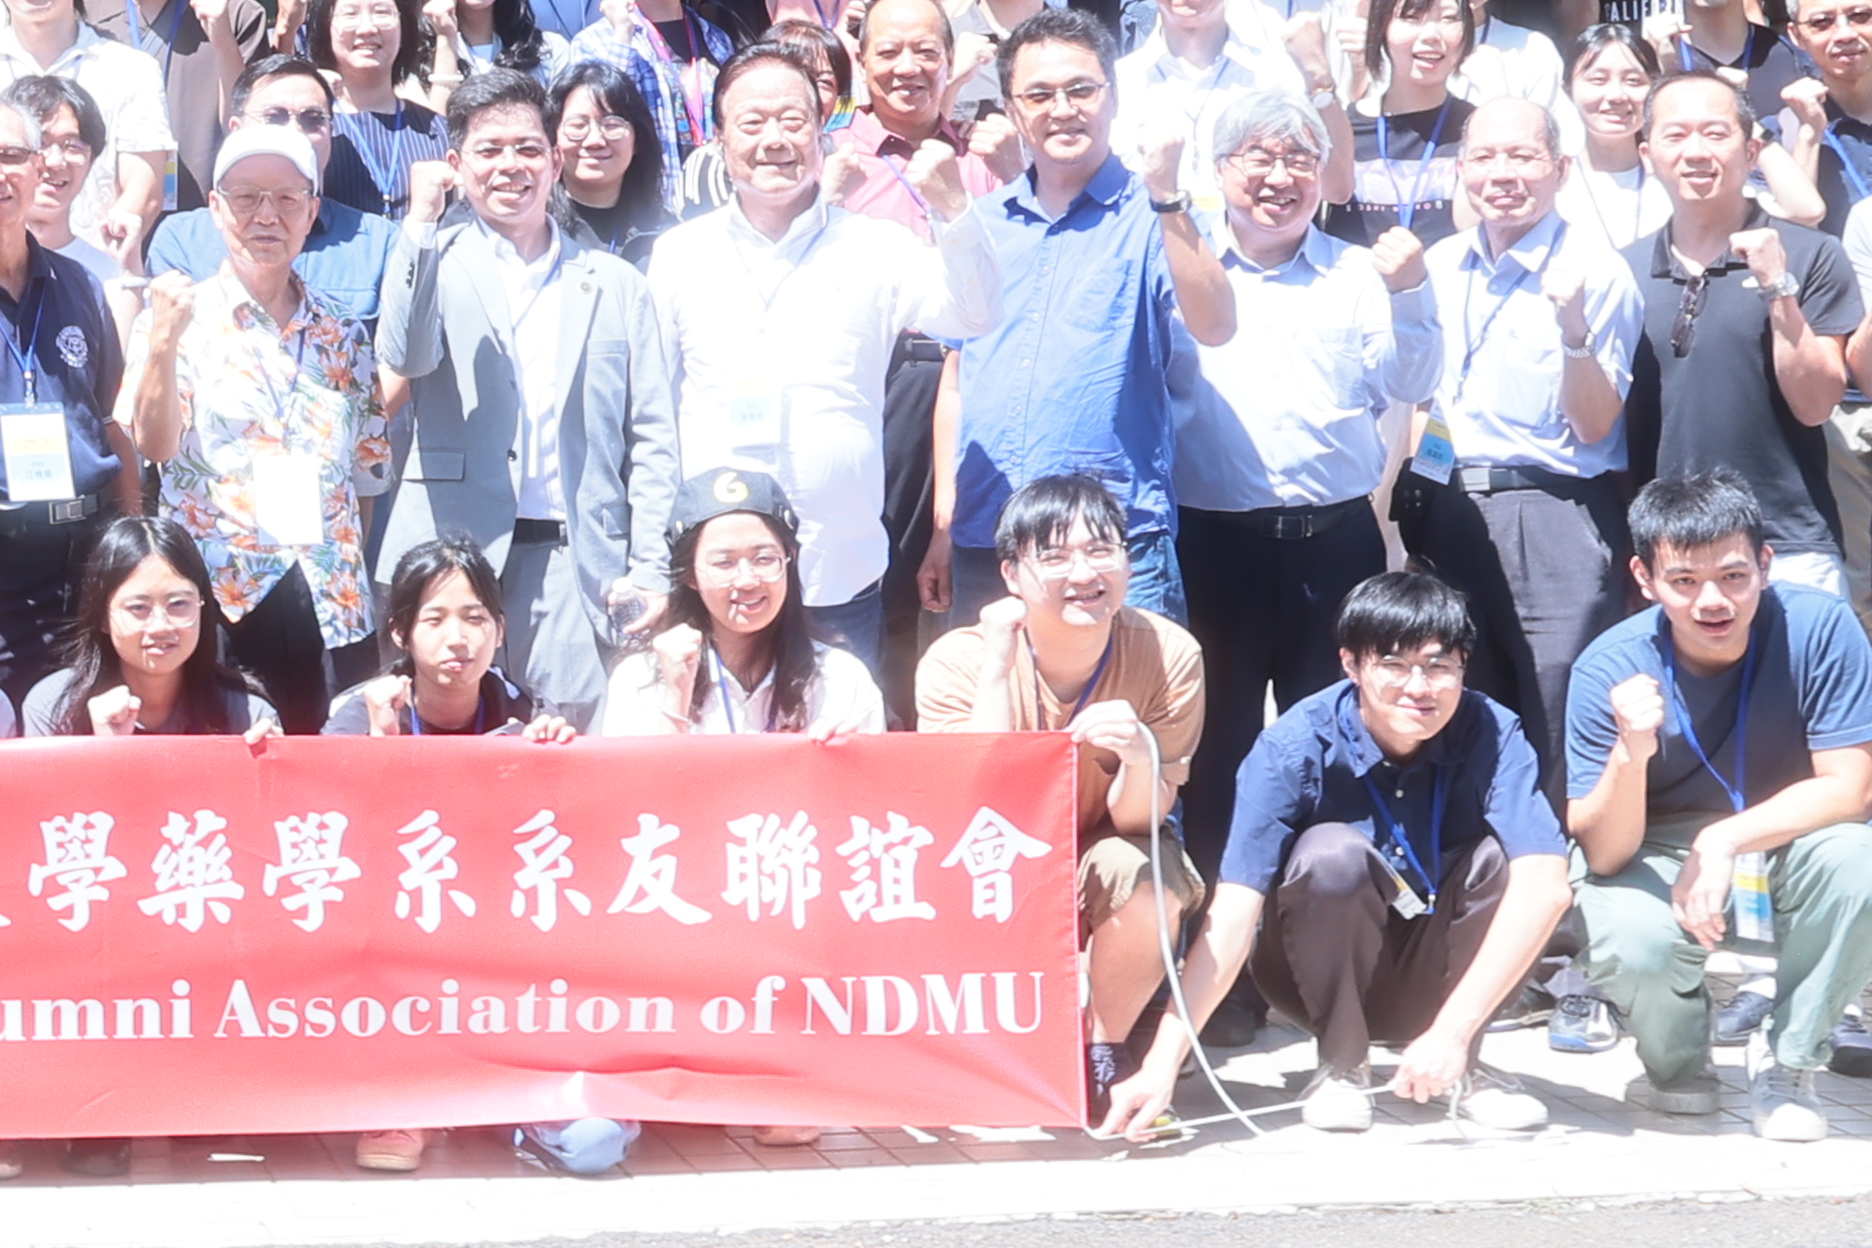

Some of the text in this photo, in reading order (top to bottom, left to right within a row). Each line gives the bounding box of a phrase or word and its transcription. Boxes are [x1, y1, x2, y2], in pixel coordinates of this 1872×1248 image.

[215, 980, 675, 1037] Association
[701, 976, 785, 1033] of
[802, 972, 1043, 1035] NDMU
